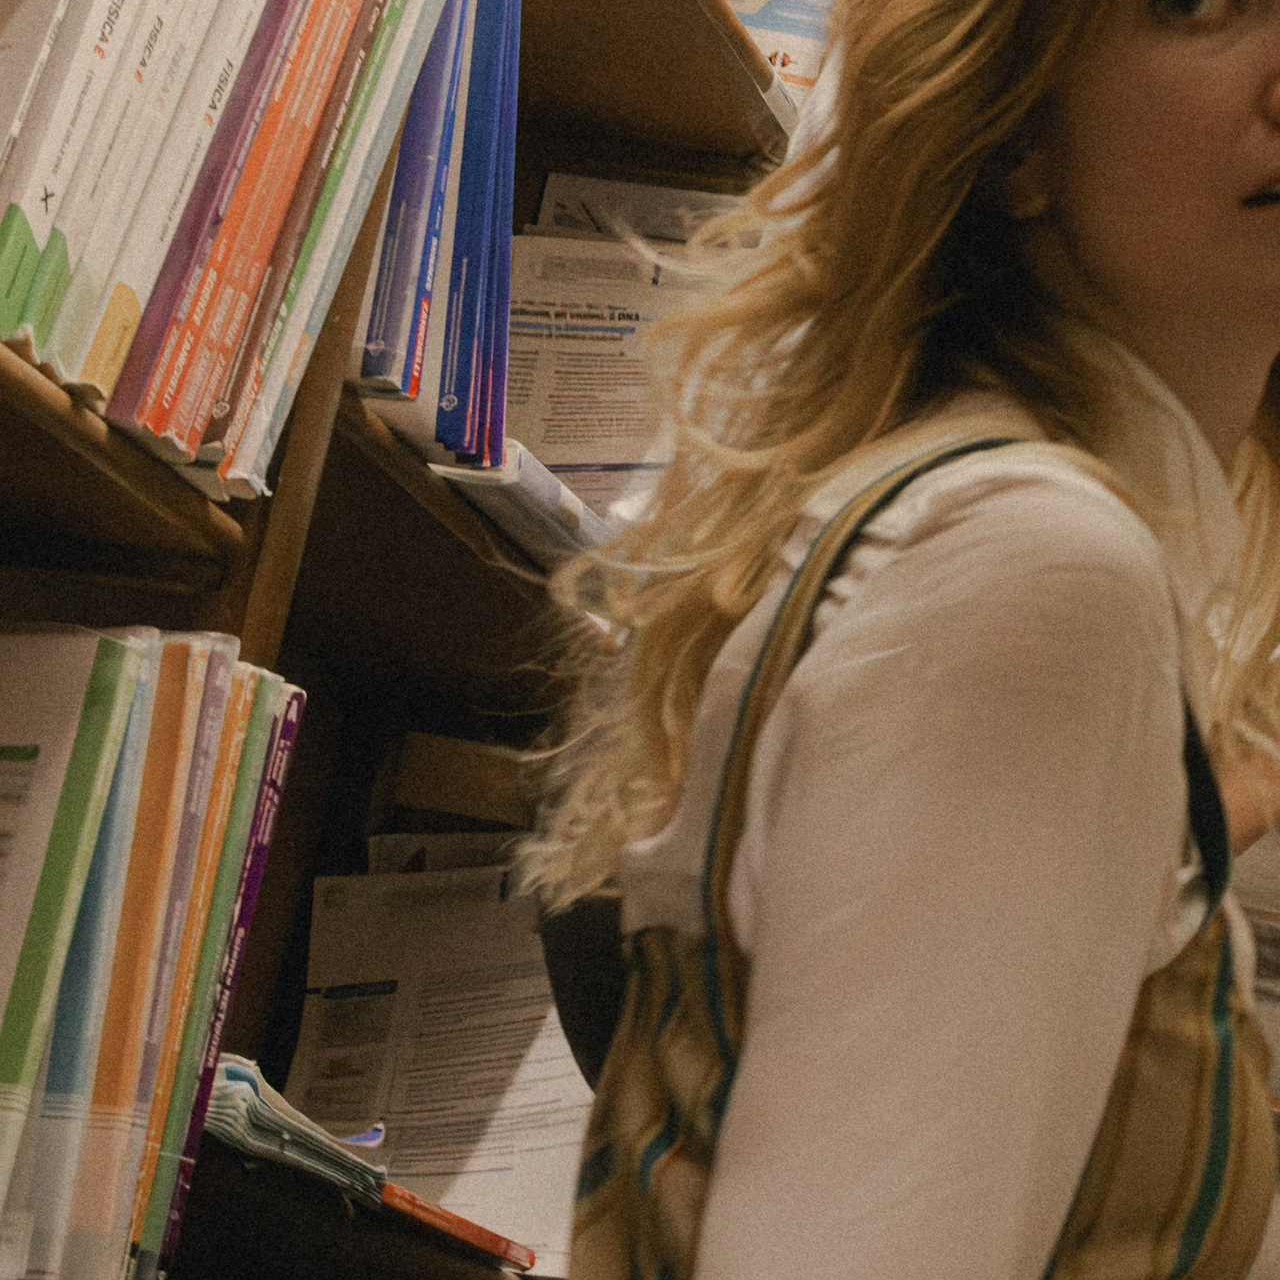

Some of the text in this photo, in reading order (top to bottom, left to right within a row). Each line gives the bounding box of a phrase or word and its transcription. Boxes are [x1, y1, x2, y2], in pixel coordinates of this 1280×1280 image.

[139, 14, 164, 69] FISICA
[208, 57, 234, 111] FISICA
[193, 268, 218, 326] SCIENZE
[162, 329, 195, 410] ZANICHELLI
